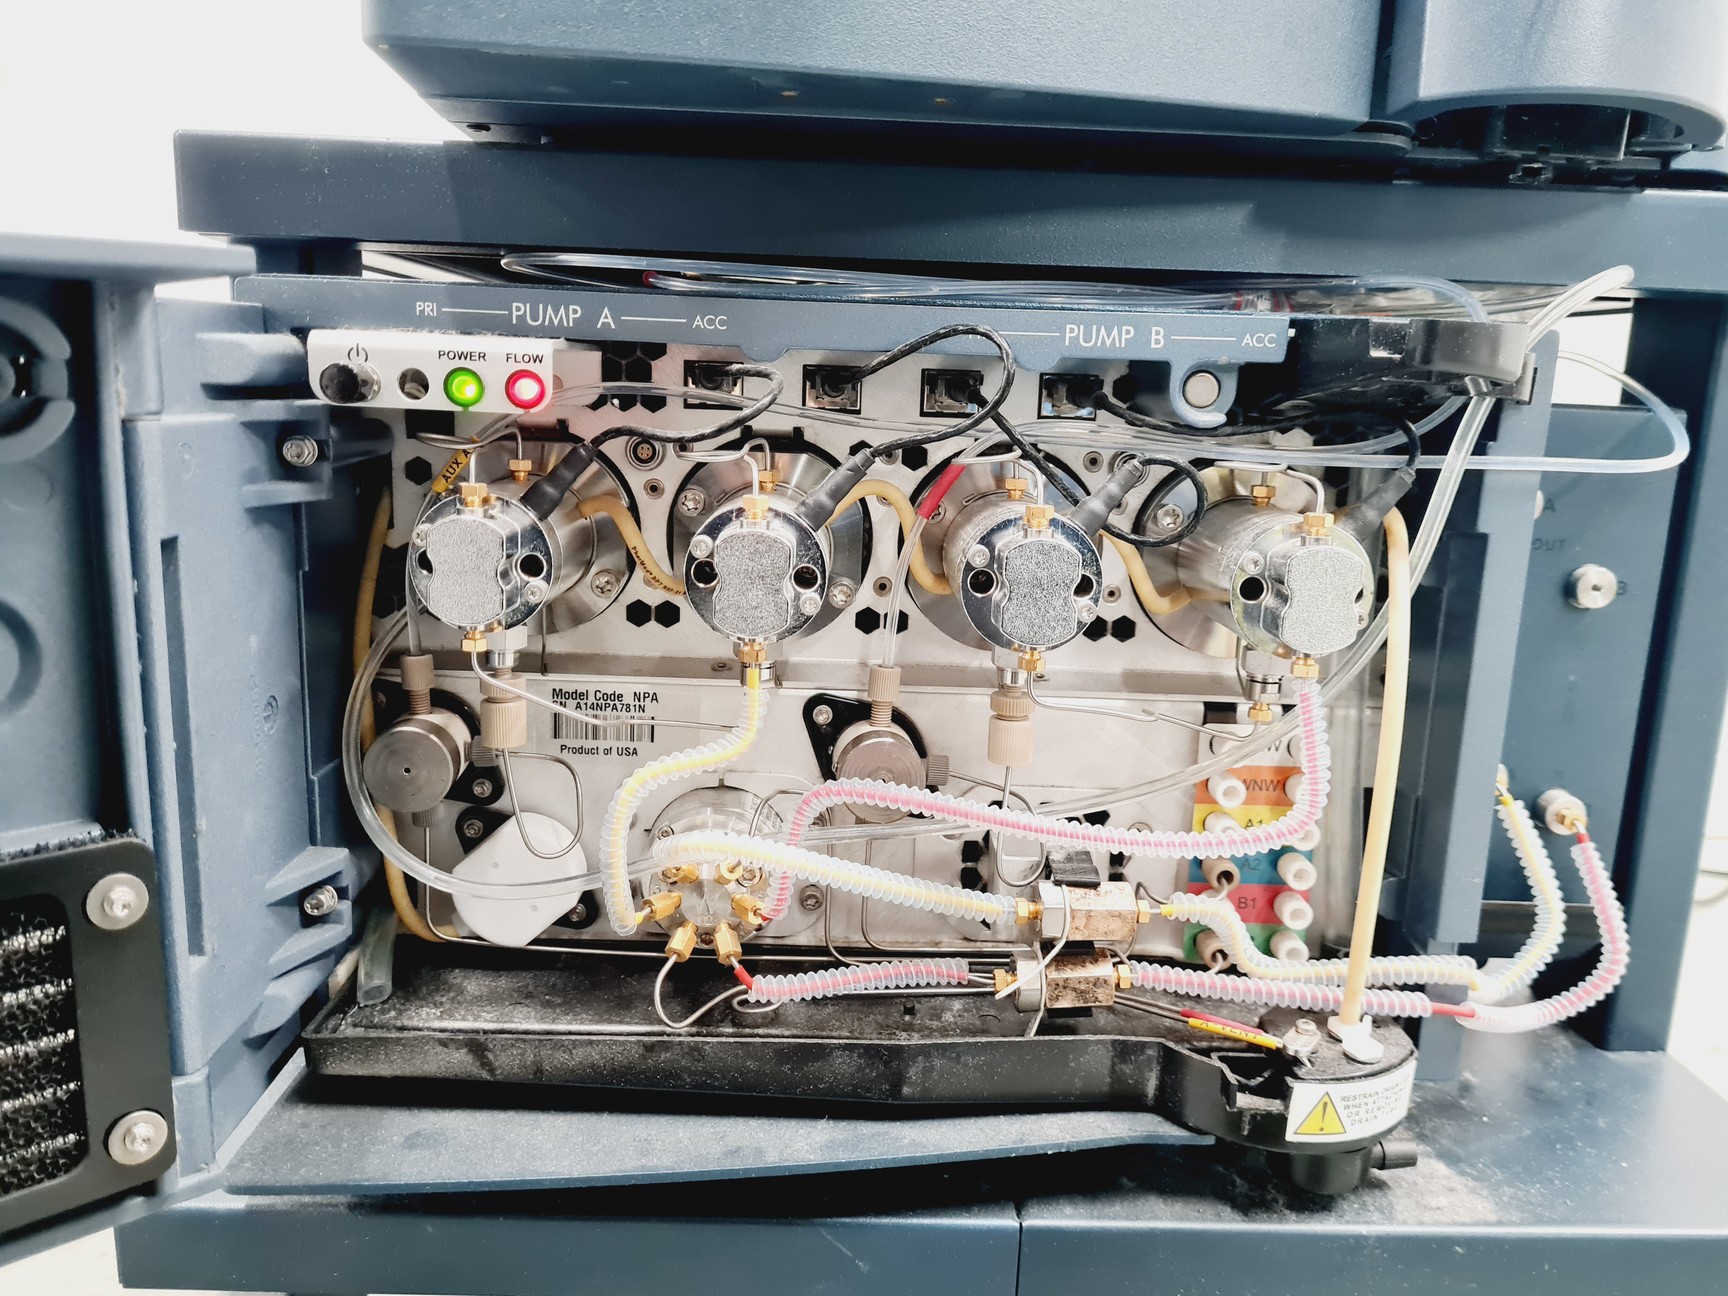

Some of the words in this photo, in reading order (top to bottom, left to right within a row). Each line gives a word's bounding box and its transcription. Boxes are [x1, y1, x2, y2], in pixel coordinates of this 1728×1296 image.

[416, 302, 437, 316] PRI
[512, 303, 582, 328] PUMP
[597, 305, 616, 330] A
[692, 315, 727, 331] ACC
[1065, 324, 1135, 348] PUMP
[1151, 326, 1165, 349] B
[1241, 333, 1276, 347] ACC
[438, 350, 487, 362] POWER
[506, 353, 544, 365] FLOW
[441, 457, 463, 484] AUX
[1544, 498, 1556, 513] A
[552, 688, 589, 701] Model
[594, 689, 624, 703] Code
[633, 691, 659, 704] NPA
[574, 701, 646, 713] A14NPA781N
[560, 744, 599, 755] Product
[603, 746, 612, 756] of
[616, 746, 638, 757] USA
[1241, 857, 1262, 872] A2
[1238, 896, 1257, 910] B1
[1340, 1090, 1380, 1103] RESTRAIN
[1343, 1101, 1369, 1111] WHEN
[1346, 1110, 1360, 1119] OR
